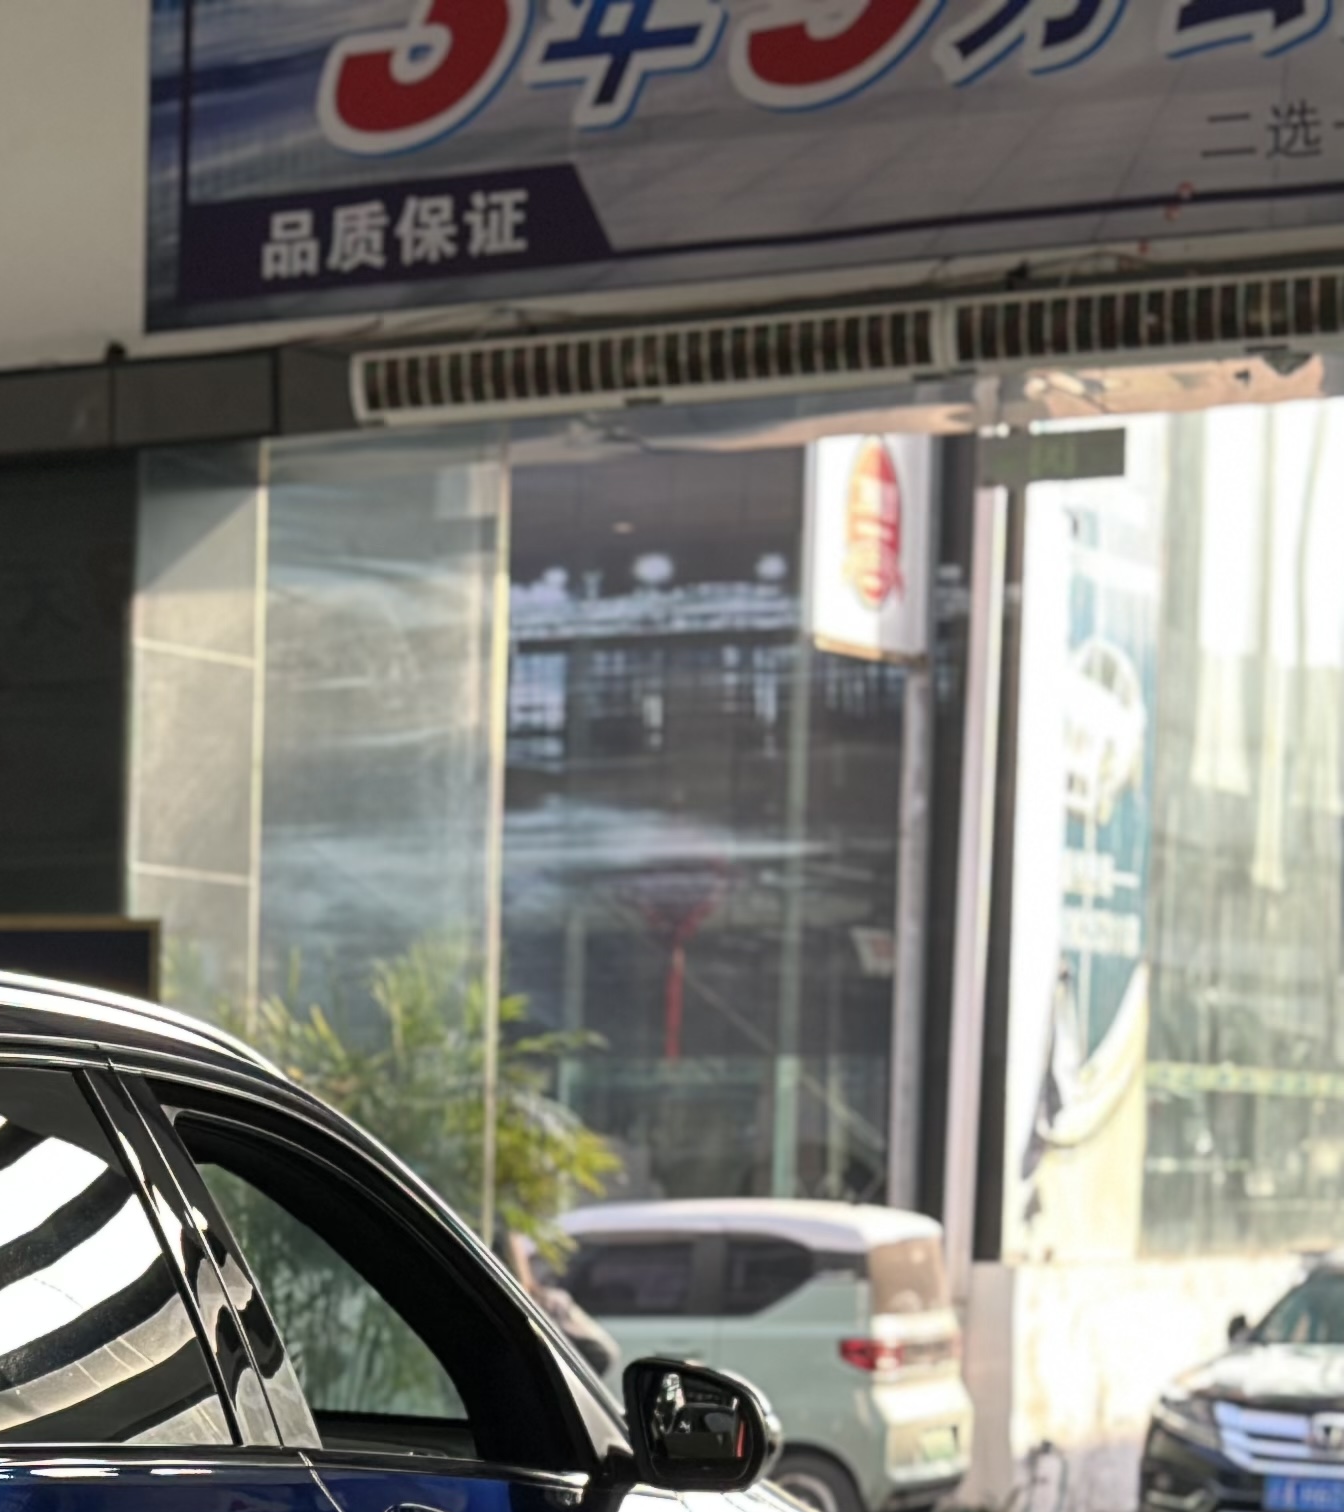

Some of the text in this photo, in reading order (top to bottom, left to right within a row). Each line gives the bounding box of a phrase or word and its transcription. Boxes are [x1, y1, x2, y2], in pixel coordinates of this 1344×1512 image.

[1199, 97, 1344, 162] 二选
[261, 188, 530, 281] 品质保证
